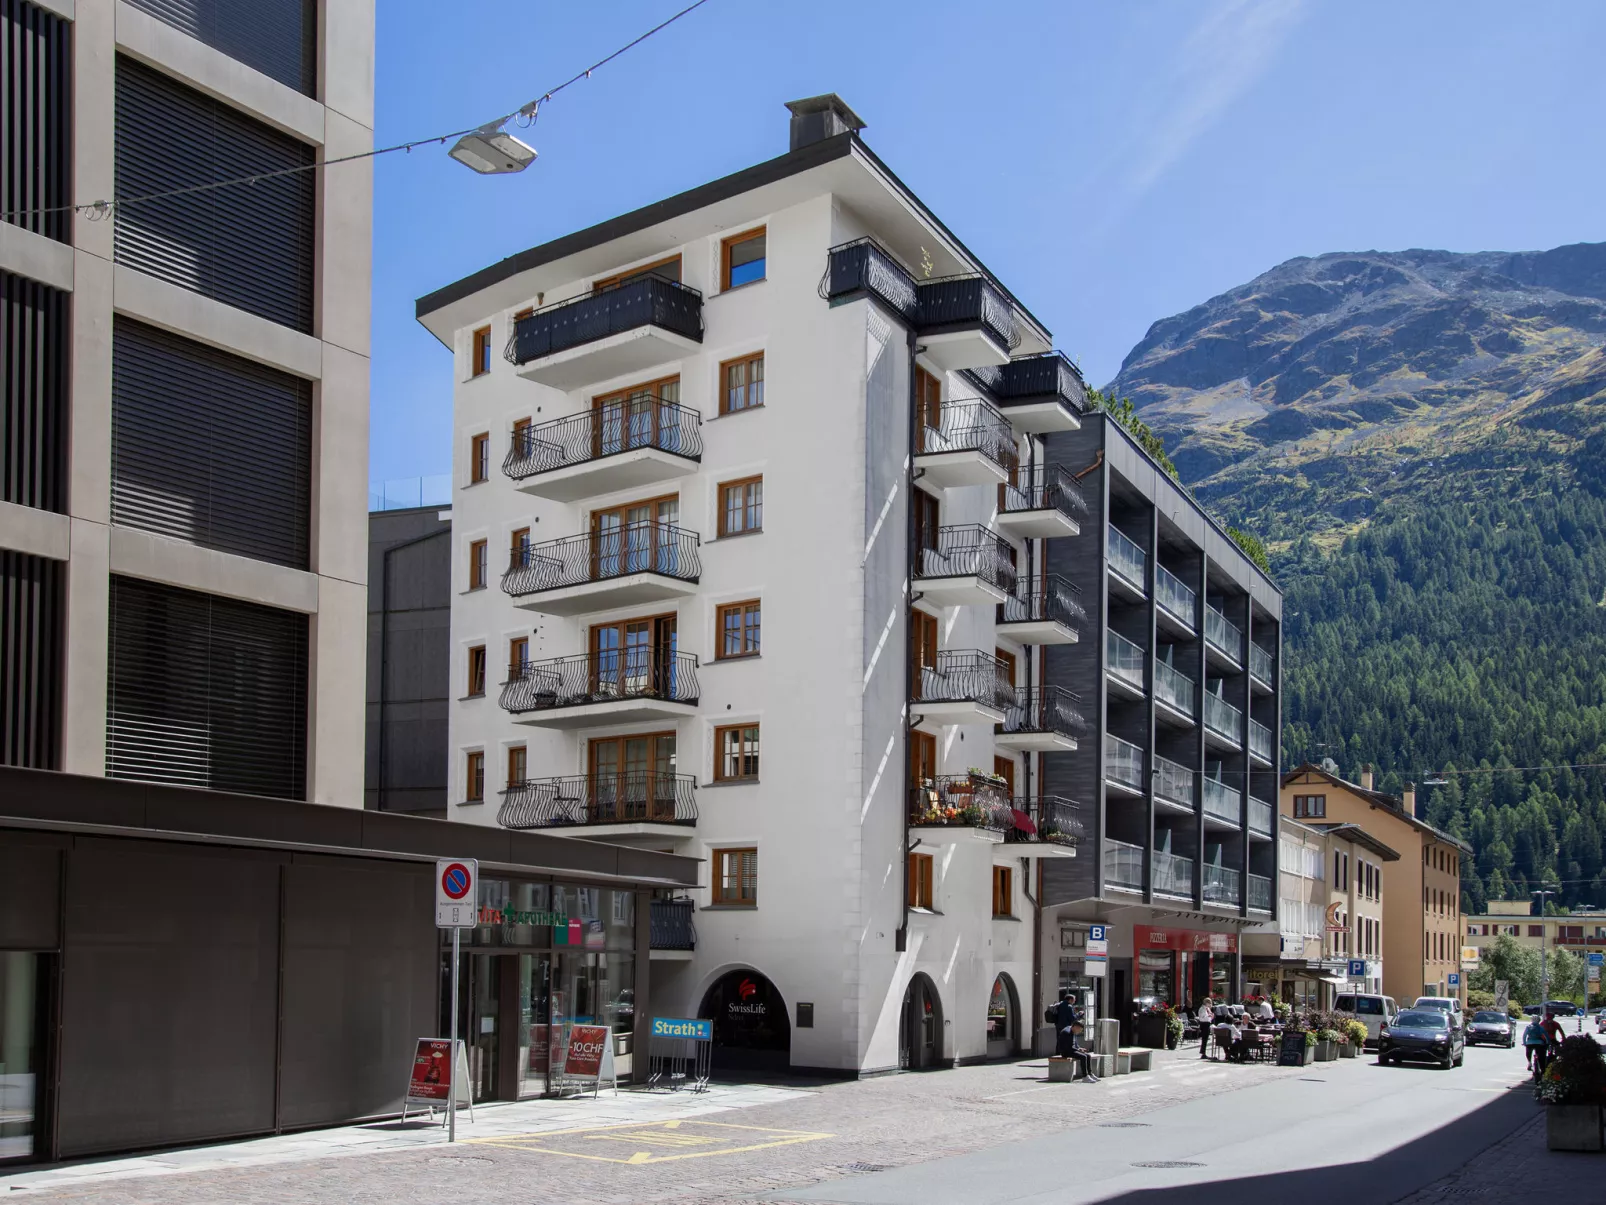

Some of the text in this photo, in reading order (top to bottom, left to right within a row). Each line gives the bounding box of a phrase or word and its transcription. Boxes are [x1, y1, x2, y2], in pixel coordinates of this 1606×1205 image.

[478, 905, 566, 926] VITA APOTHEKE
[1092, 928, 1102, 939] B
[1353, 963, 1360, 974] P
[655, 1021, 695, 1036] Strath
[583, 1042, 603, 1053] CHF
